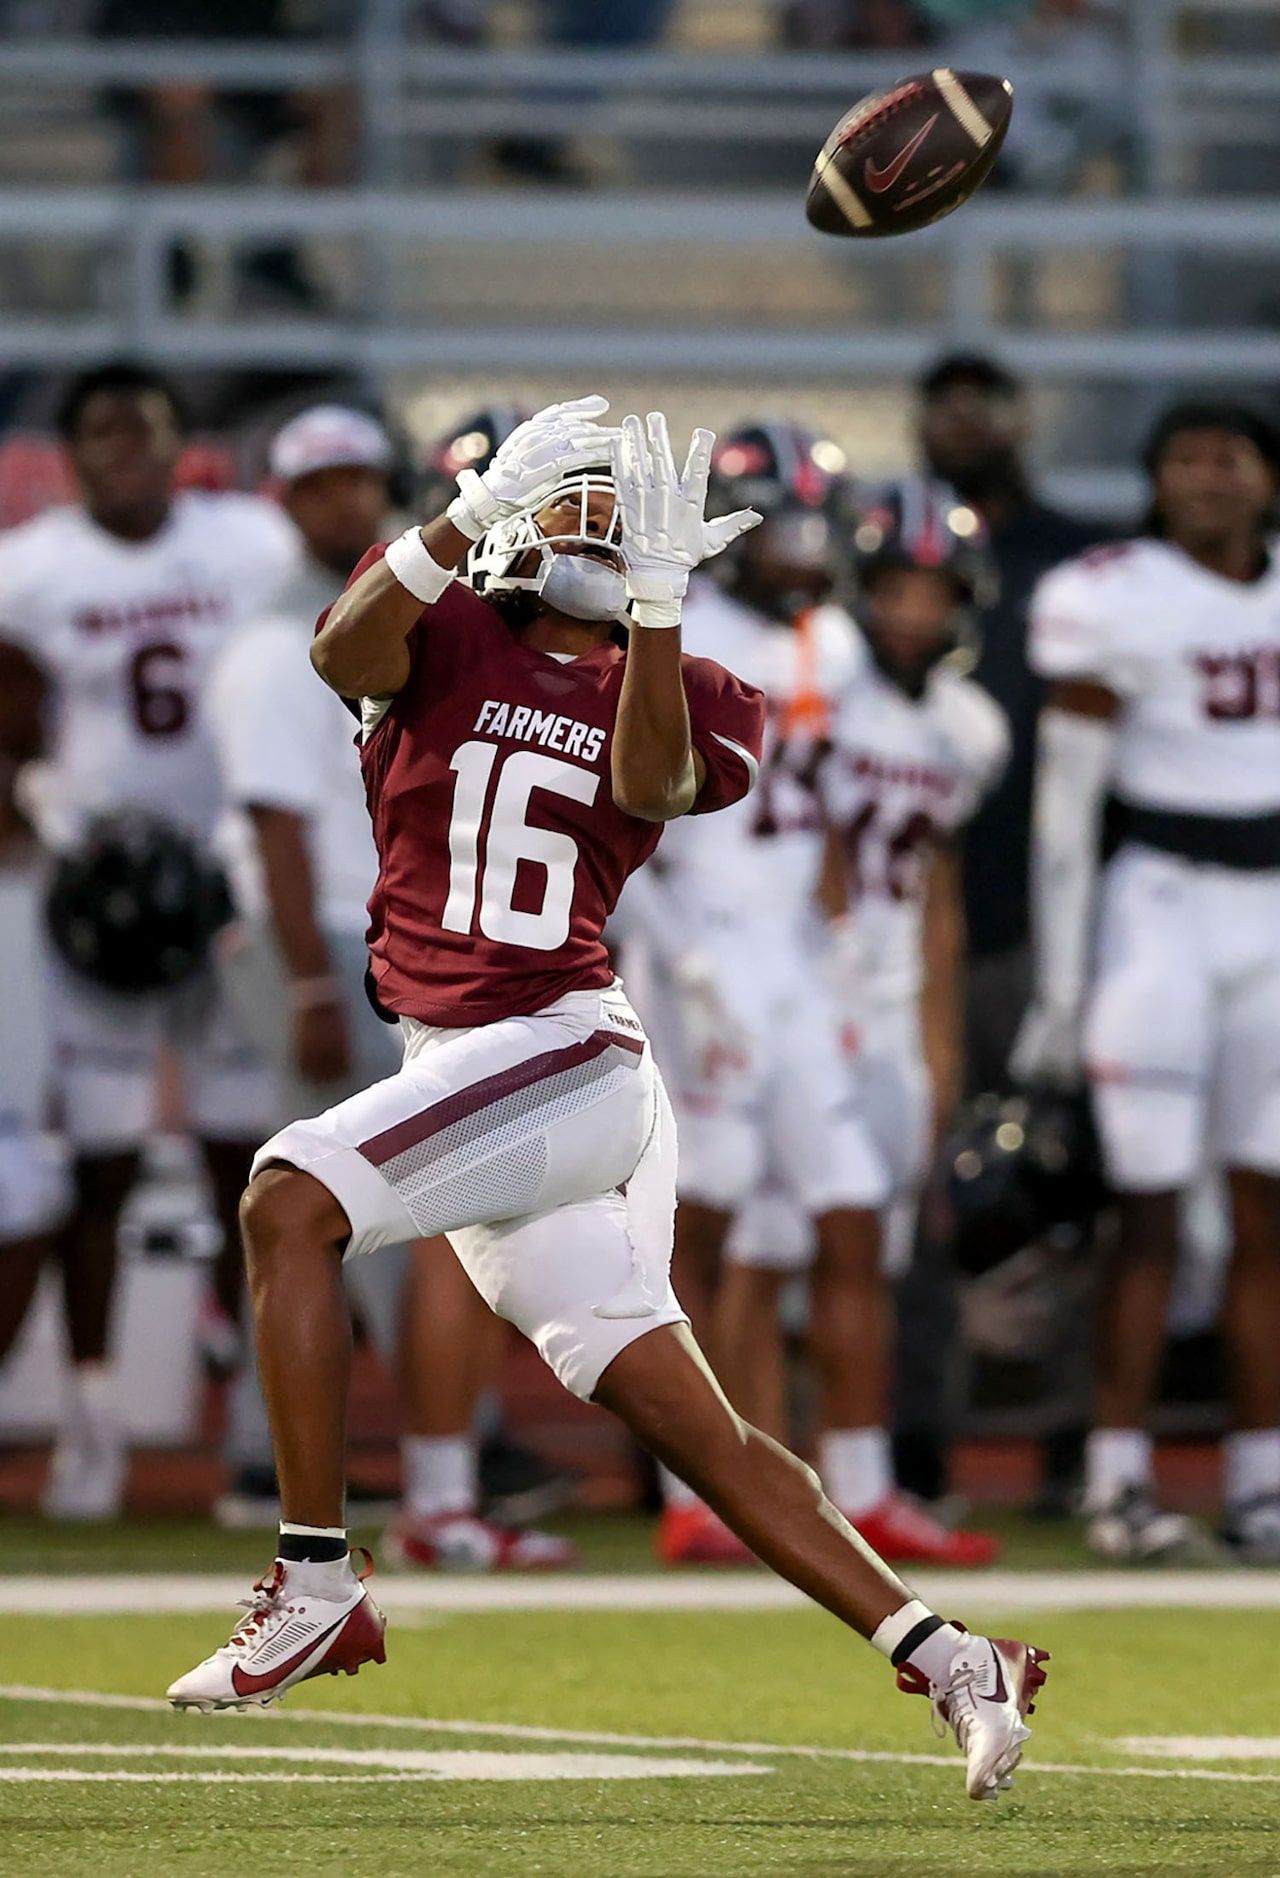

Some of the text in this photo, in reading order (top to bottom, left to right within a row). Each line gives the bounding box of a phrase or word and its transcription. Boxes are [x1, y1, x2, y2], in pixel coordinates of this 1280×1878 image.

[133, 642, 188, 738] 6
[472, 699, 607, 763] FARMERS
[441, 740, 601, 951] 16
